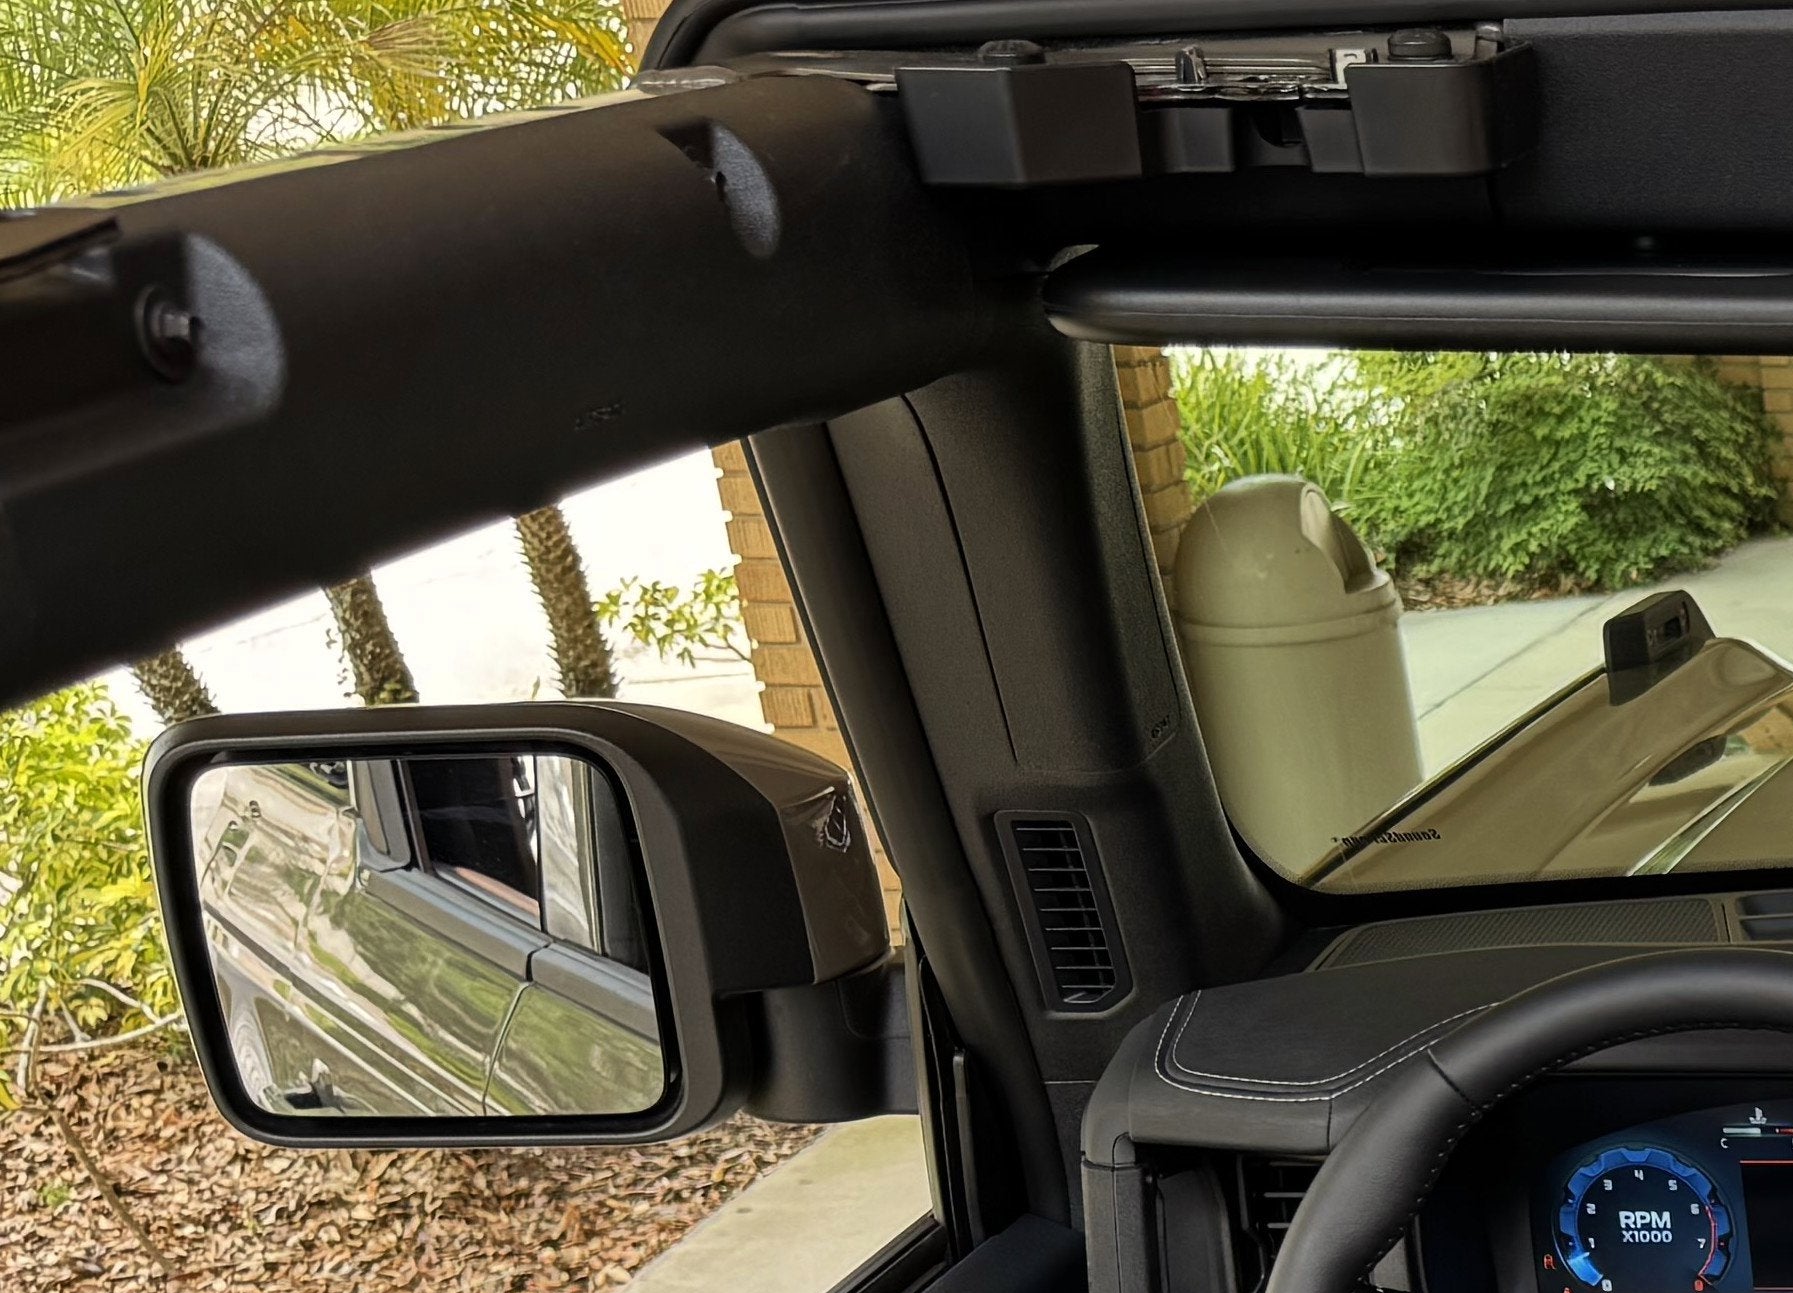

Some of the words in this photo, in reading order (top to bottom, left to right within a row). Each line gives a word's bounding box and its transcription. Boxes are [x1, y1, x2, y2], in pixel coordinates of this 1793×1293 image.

[1720, 1138, 1729, 1149] C
[1634, 1169, 1644, 1181] 4
[1603, 1179, 1613, 1191] 3
[1668, 1179, 1678, 1191] 5
[1586, 1203, 1596, 1215] 2
[1690, 1203, 1700, 1215] 6
[1618, 1210, 1672, 1229] RPM
[1622, 1230, 1673, 1243] X1000
[1588, 1237, 1596, 1249] 1
[1696, 1238, 1706, 1249] 7
[1601, 1279, 1613, 1292] 0
